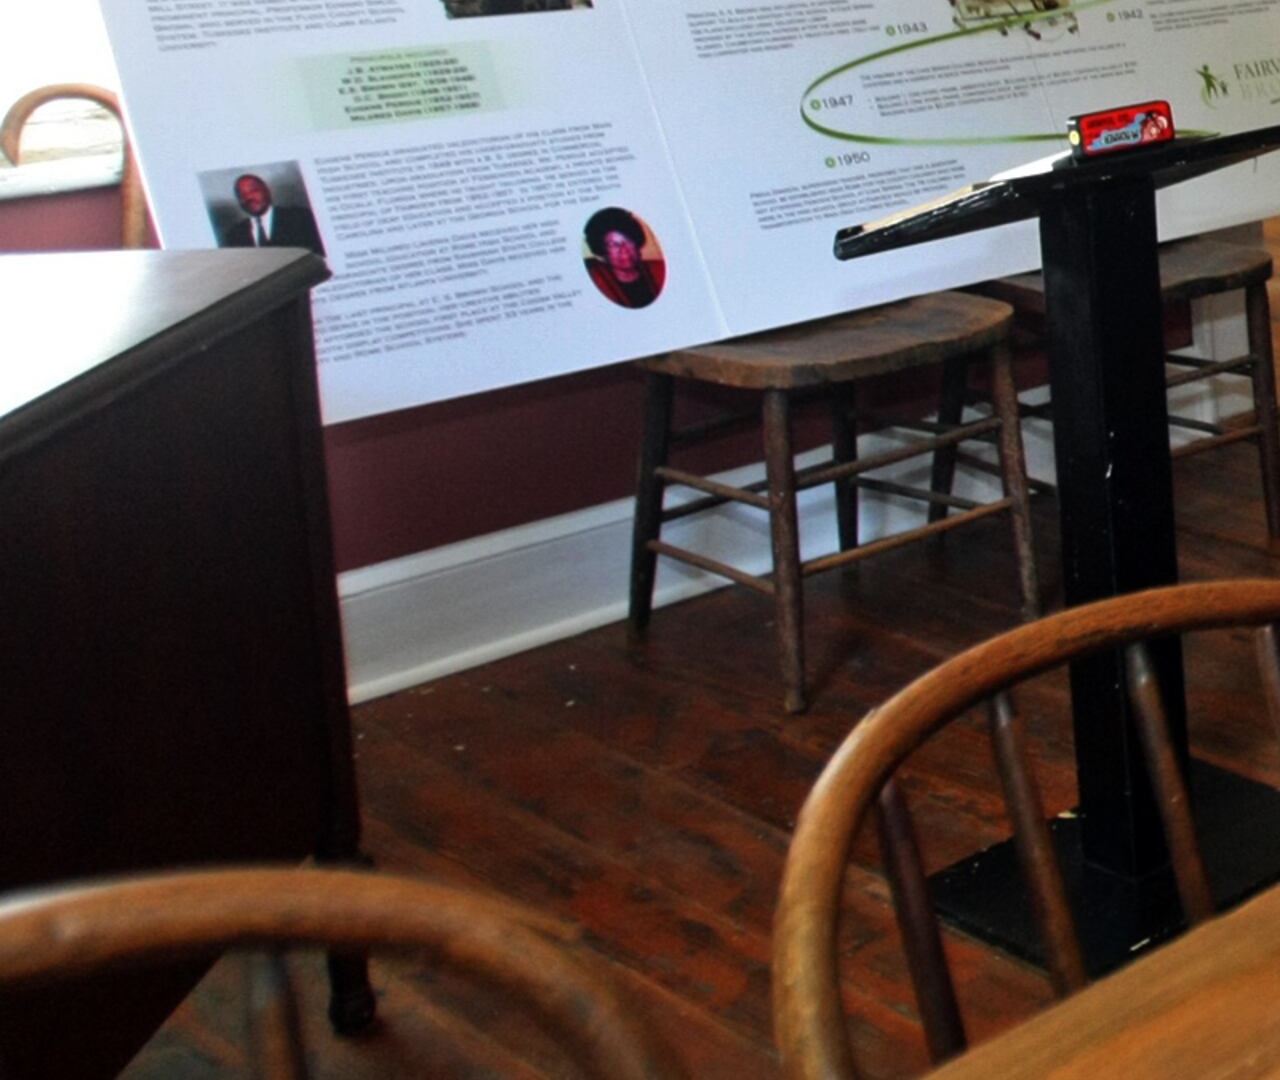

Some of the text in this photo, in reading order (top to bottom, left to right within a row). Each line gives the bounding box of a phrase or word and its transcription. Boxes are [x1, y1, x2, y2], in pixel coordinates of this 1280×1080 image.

[897, 22, 928, 35] 1943
[822, 95, 853, 110] 1947
[837, 151, 871, 166] 1950
